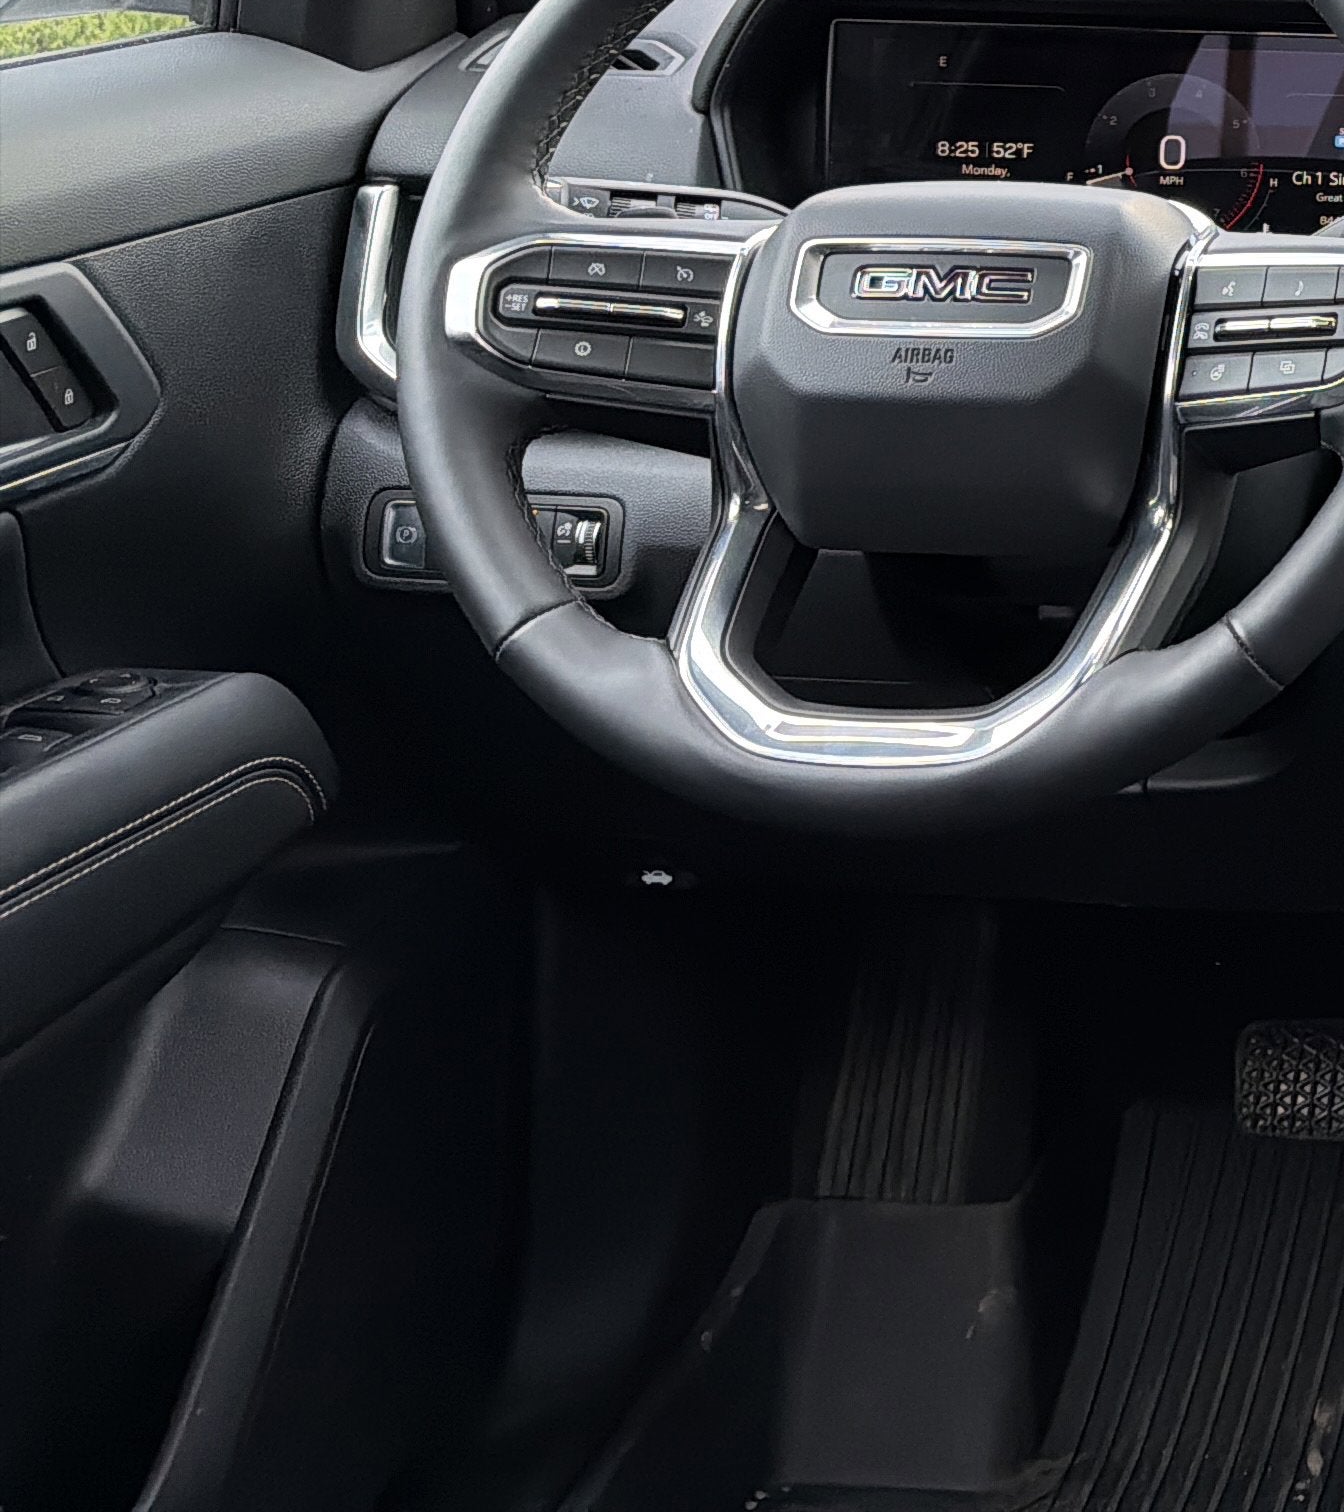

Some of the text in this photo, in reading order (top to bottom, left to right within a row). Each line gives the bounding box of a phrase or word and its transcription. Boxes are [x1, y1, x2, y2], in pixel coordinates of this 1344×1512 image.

[936, 140, 1035, 159] 8:25 52°F
[1158, 134, 1187, 170] 0
[1159, 175, 1185, 186] MPH
[1269, 178, 1279, 188] H
[1291, 171, 1314, 185] Ch
[1315, 172, 1323, 186] 1
[1316, 192, 1344, 204] Great
[852, 263, 1037, 303] GMC
[891, 347, 955, 364] AIRBAG
